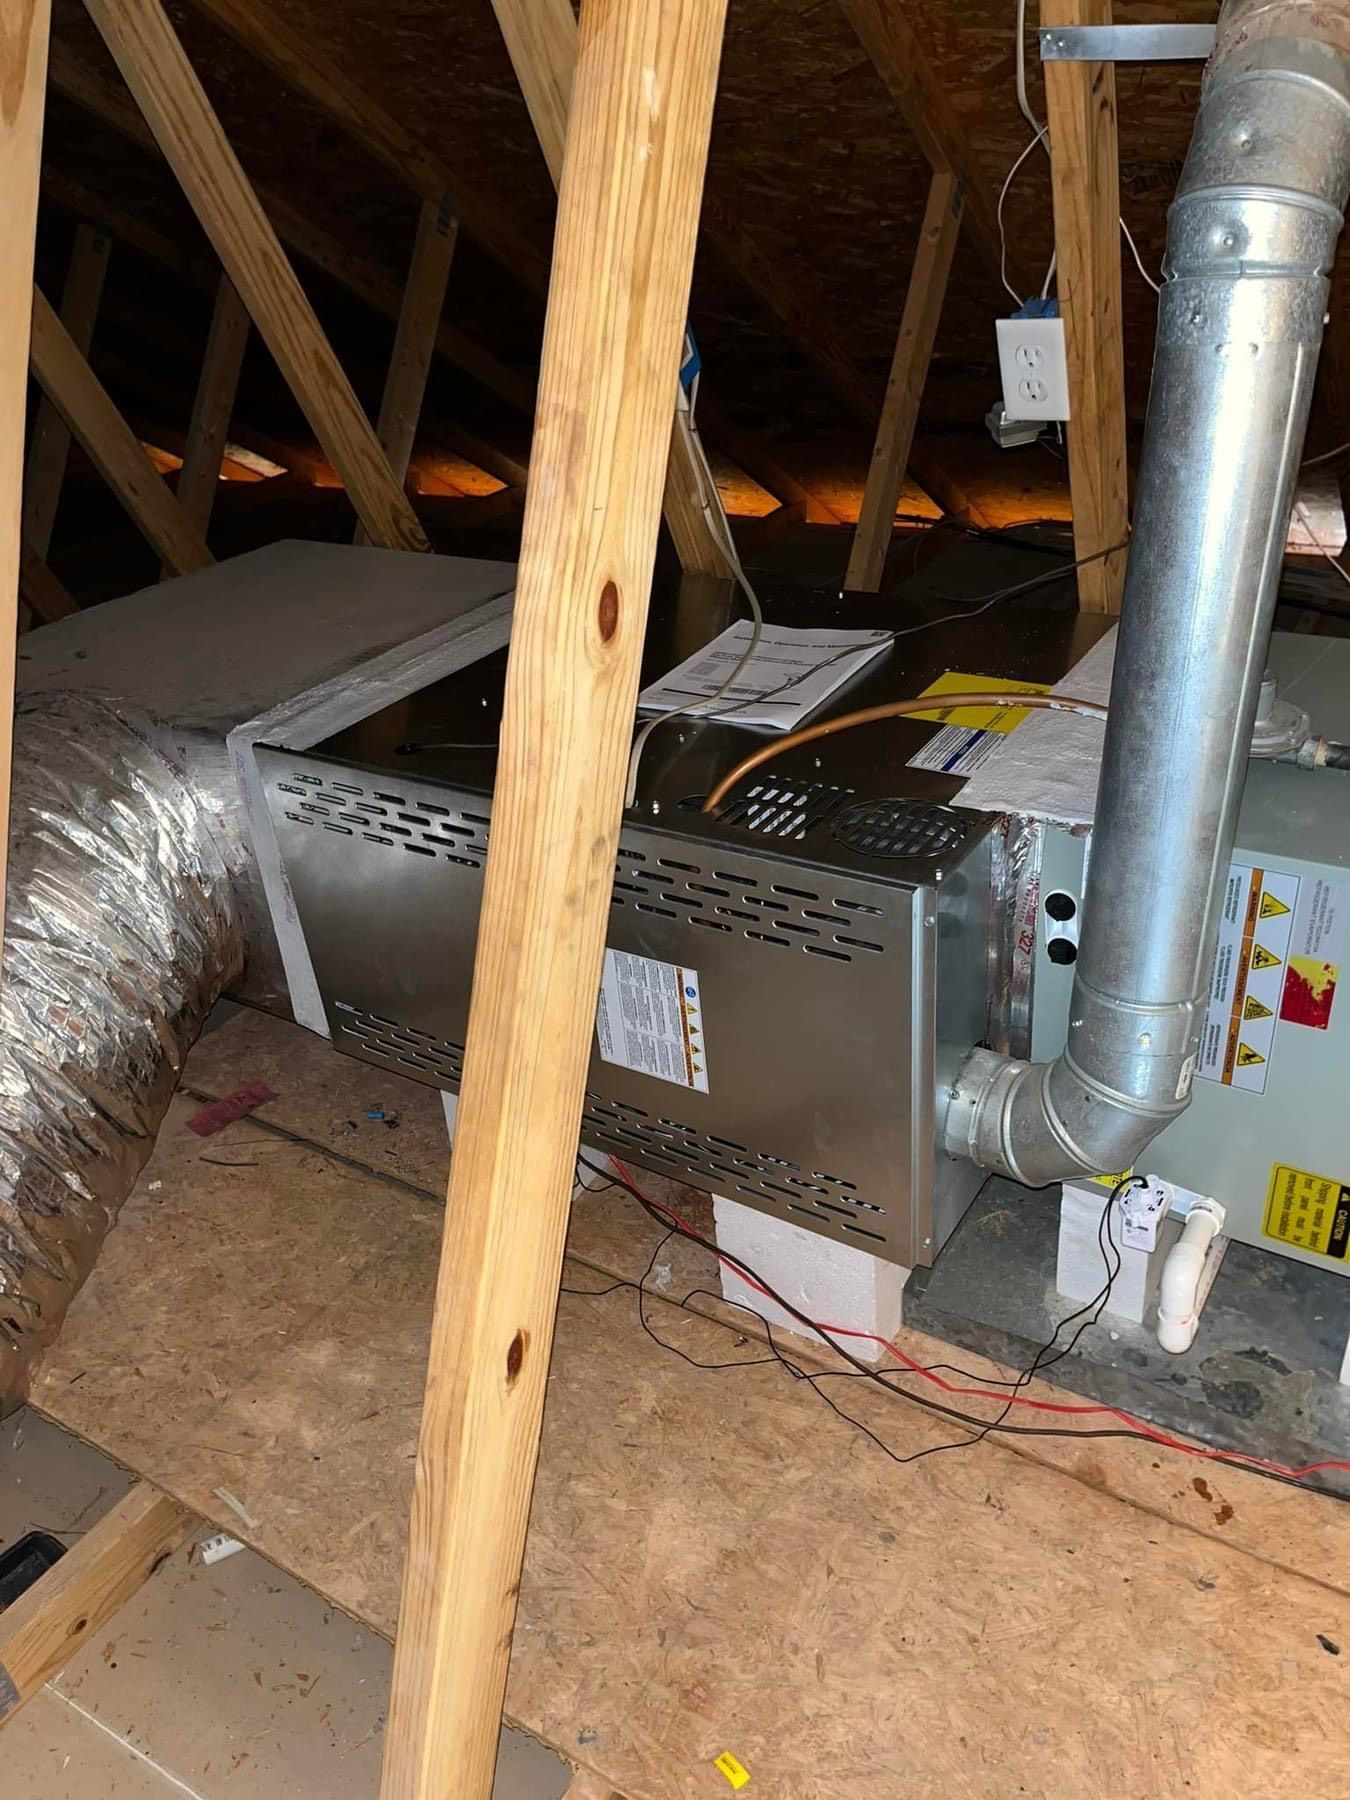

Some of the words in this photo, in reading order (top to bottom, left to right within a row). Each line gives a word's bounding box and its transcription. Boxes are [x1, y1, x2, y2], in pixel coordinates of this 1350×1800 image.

[1018, 930, 1034, 955] 327
[1315, 1182, 1332, 1205] Shipping
[1333, 1209, 1348, 1241] CAUTION
